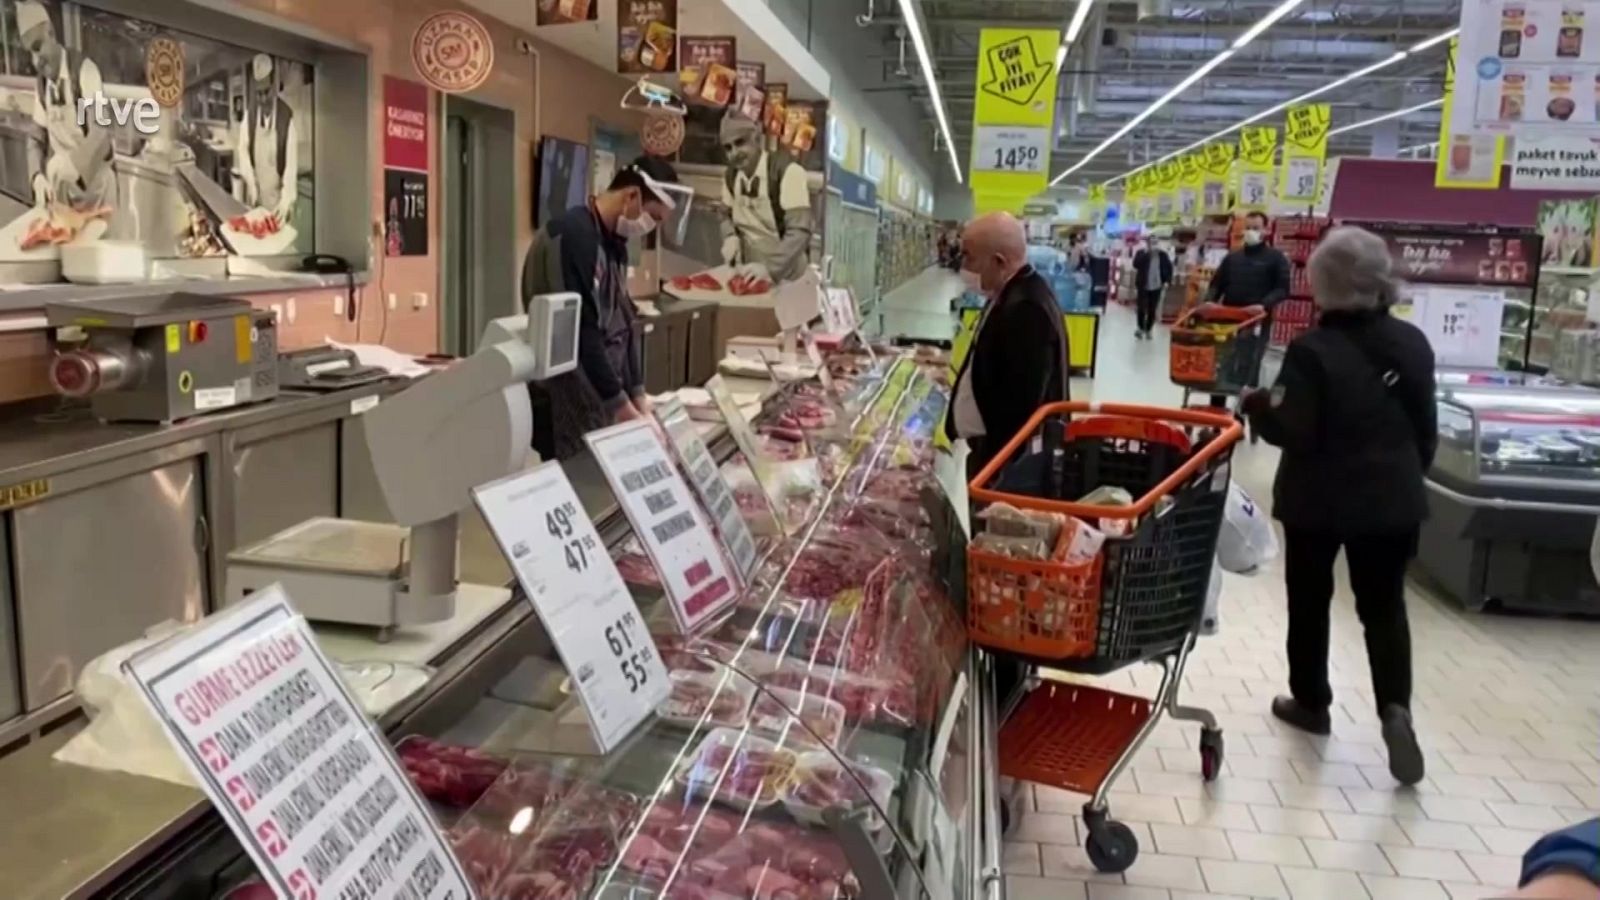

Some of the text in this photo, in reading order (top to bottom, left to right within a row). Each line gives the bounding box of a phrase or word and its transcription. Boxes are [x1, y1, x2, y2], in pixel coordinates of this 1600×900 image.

[423, 19, 474, 46] UZMAN
[1517, 148, 1597, 162] paket tavuk
[1516, 166, 1562, 179] meyve
[174, 666, 241, 727] GURME
